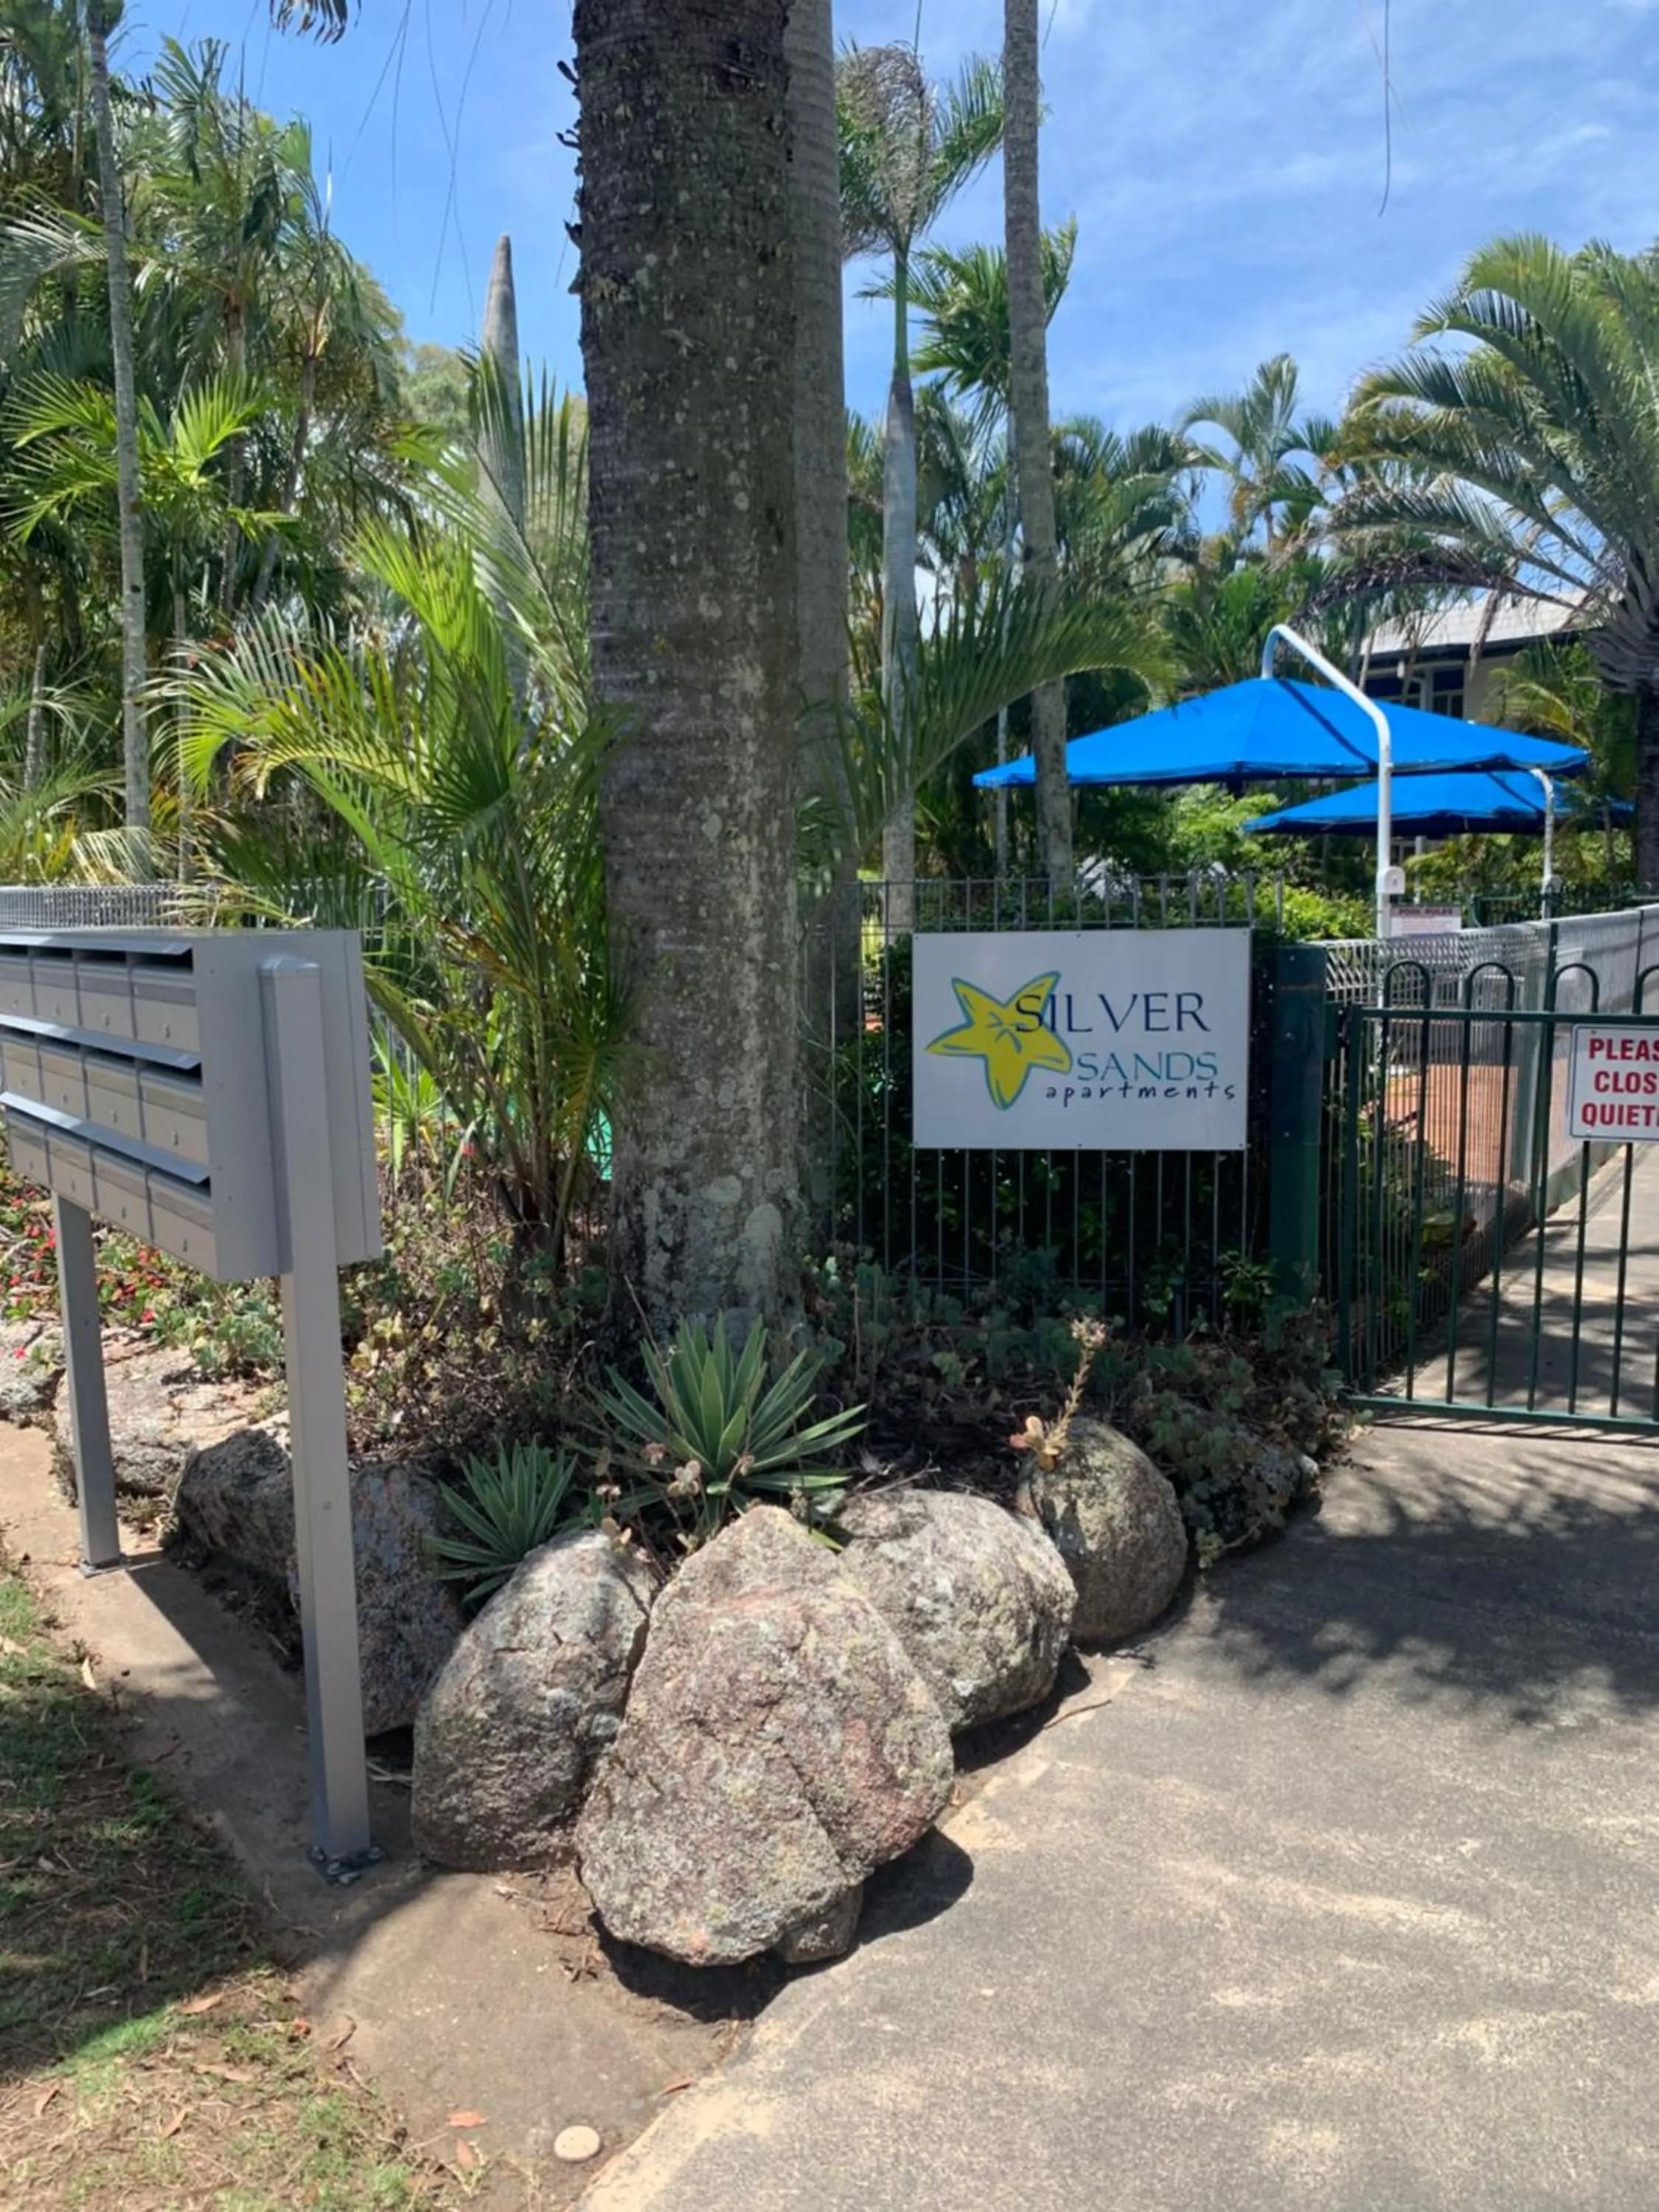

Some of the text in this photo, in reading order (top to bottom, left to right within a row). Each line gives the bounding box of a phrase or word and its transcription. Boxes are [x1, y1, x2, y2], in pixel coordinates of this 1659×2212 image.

[1015, 992, 1211, 1034] SILVER
[1076, 1051, 1219, 1082] SANDS
[1046, 1081, 1237, 1107] apartments
[1581, 1103, 1659, 1127] QUIET
